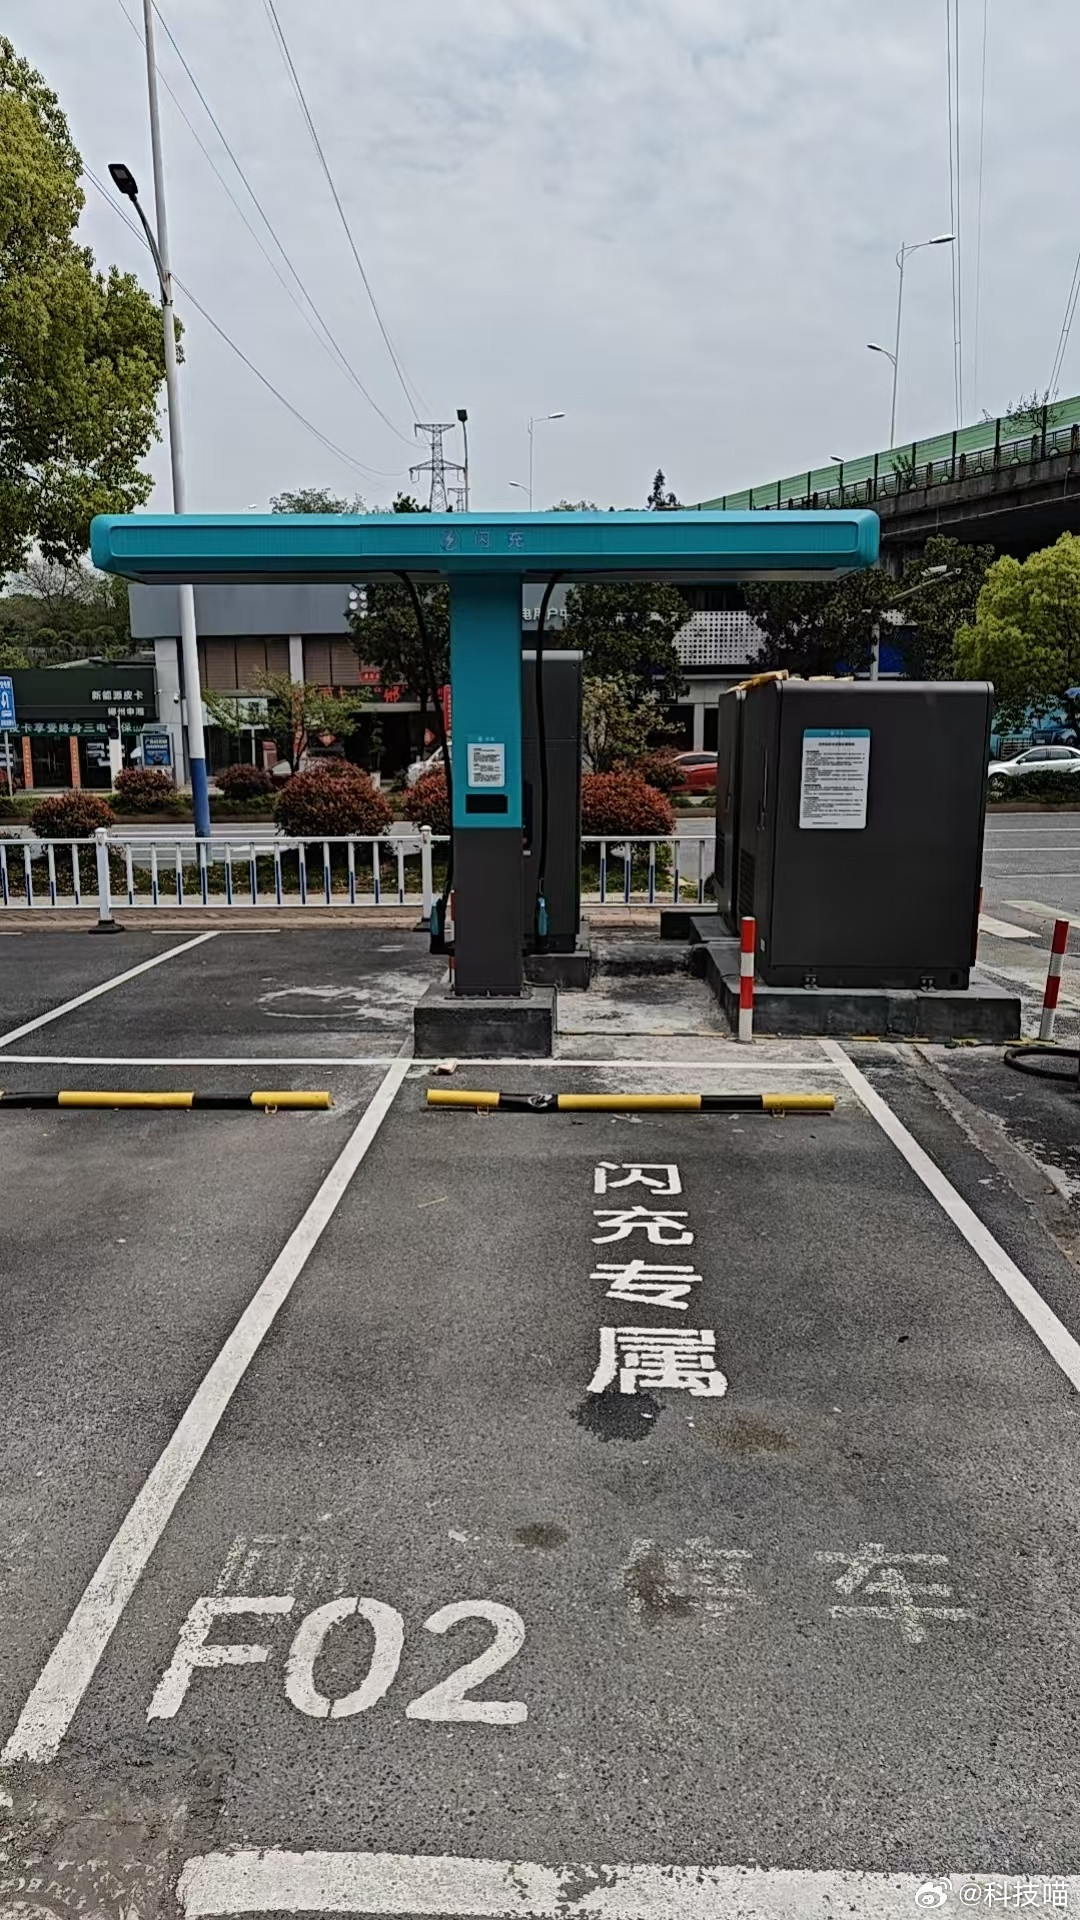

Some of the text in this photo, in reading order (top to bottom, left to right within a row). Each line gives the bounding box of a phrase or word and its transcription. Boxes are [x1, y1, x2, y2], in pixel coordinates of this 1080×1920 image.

[474, 530, 525, 549] 闪充
[91, 690, 144, 701] 新能源皮卡
[586, 1161, 728, 1397] 闪充专属
[146, 1596, 528, 1725] F02
